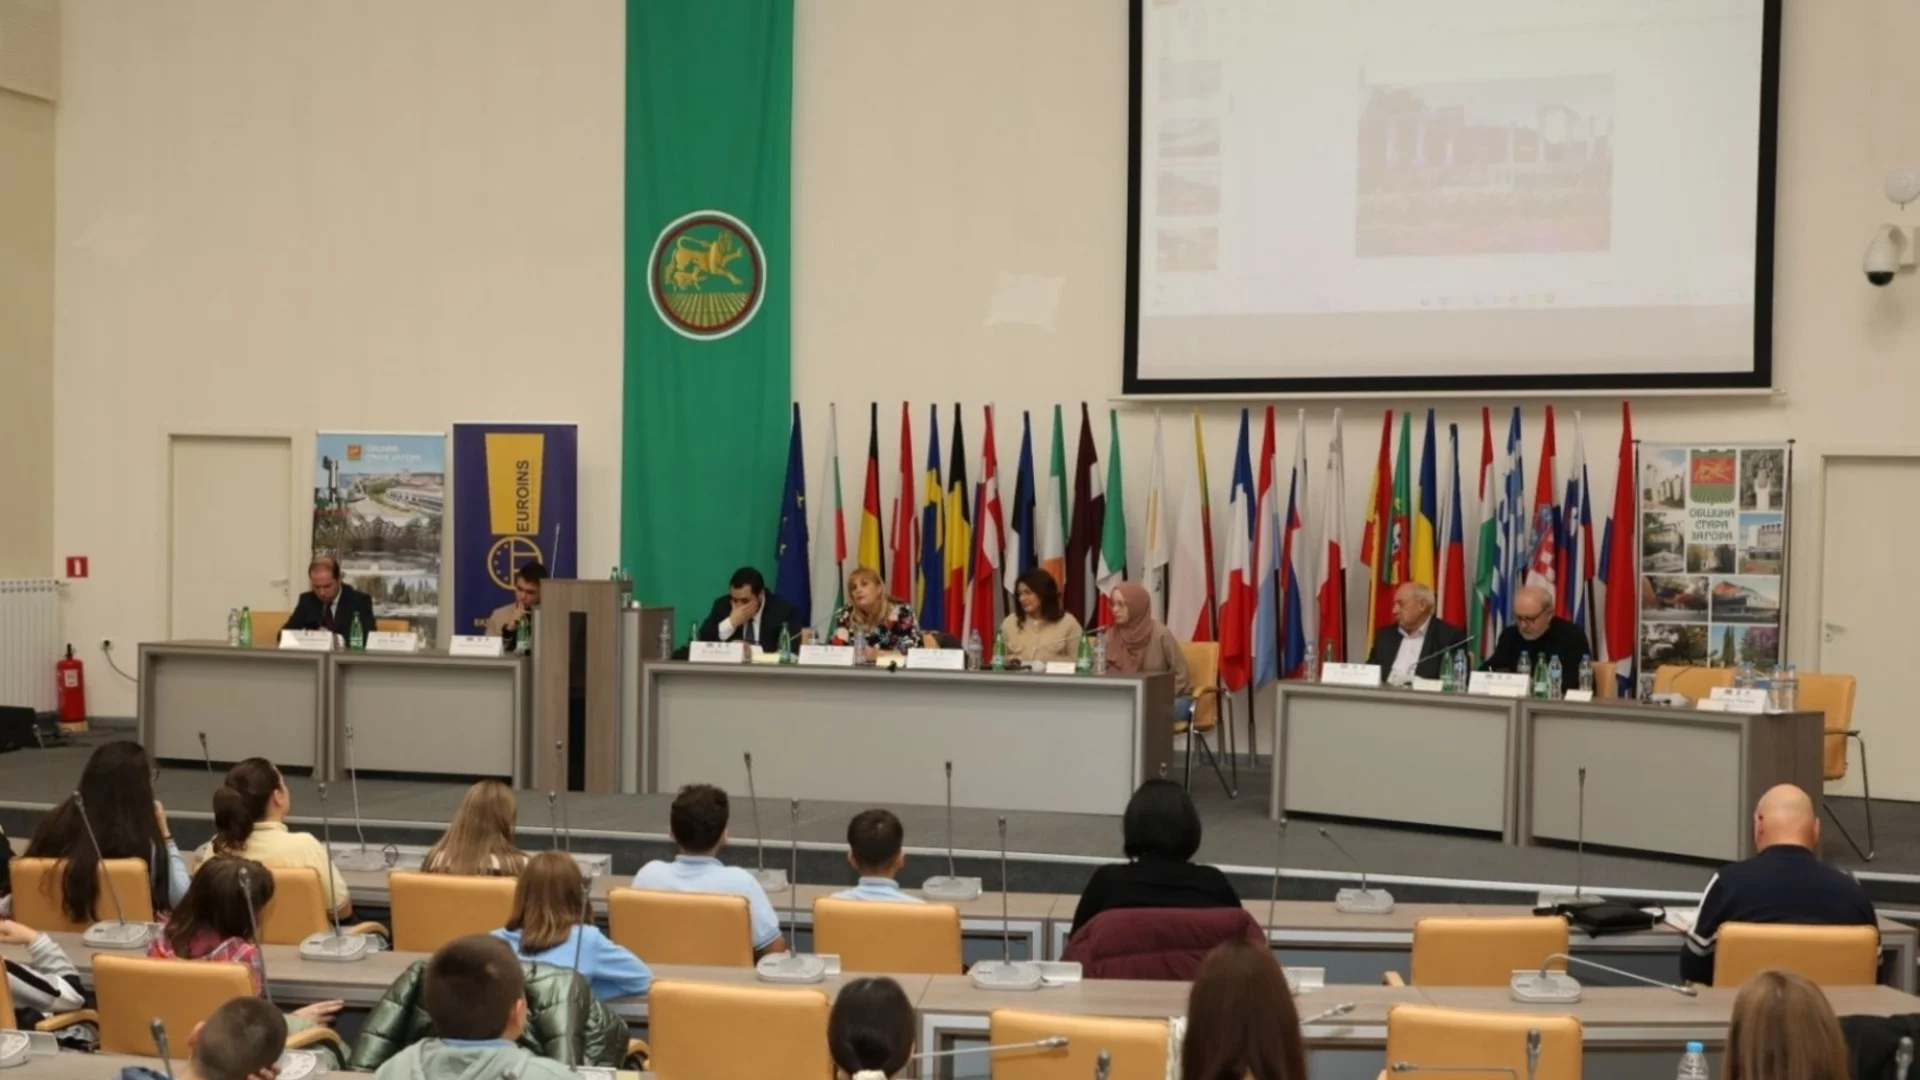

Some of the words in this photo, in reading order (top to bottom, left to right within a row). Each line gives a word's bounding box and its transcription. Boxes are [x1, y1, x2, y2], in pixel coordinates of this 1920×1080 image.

[516, 460, 530, 532] EUROINS
[1688, 508, 1735, 518] ОБЩИНА
[1695, 519, 1729, 530] СТАРА
[1691, 531, 1733, 541] ЗАГОРА
